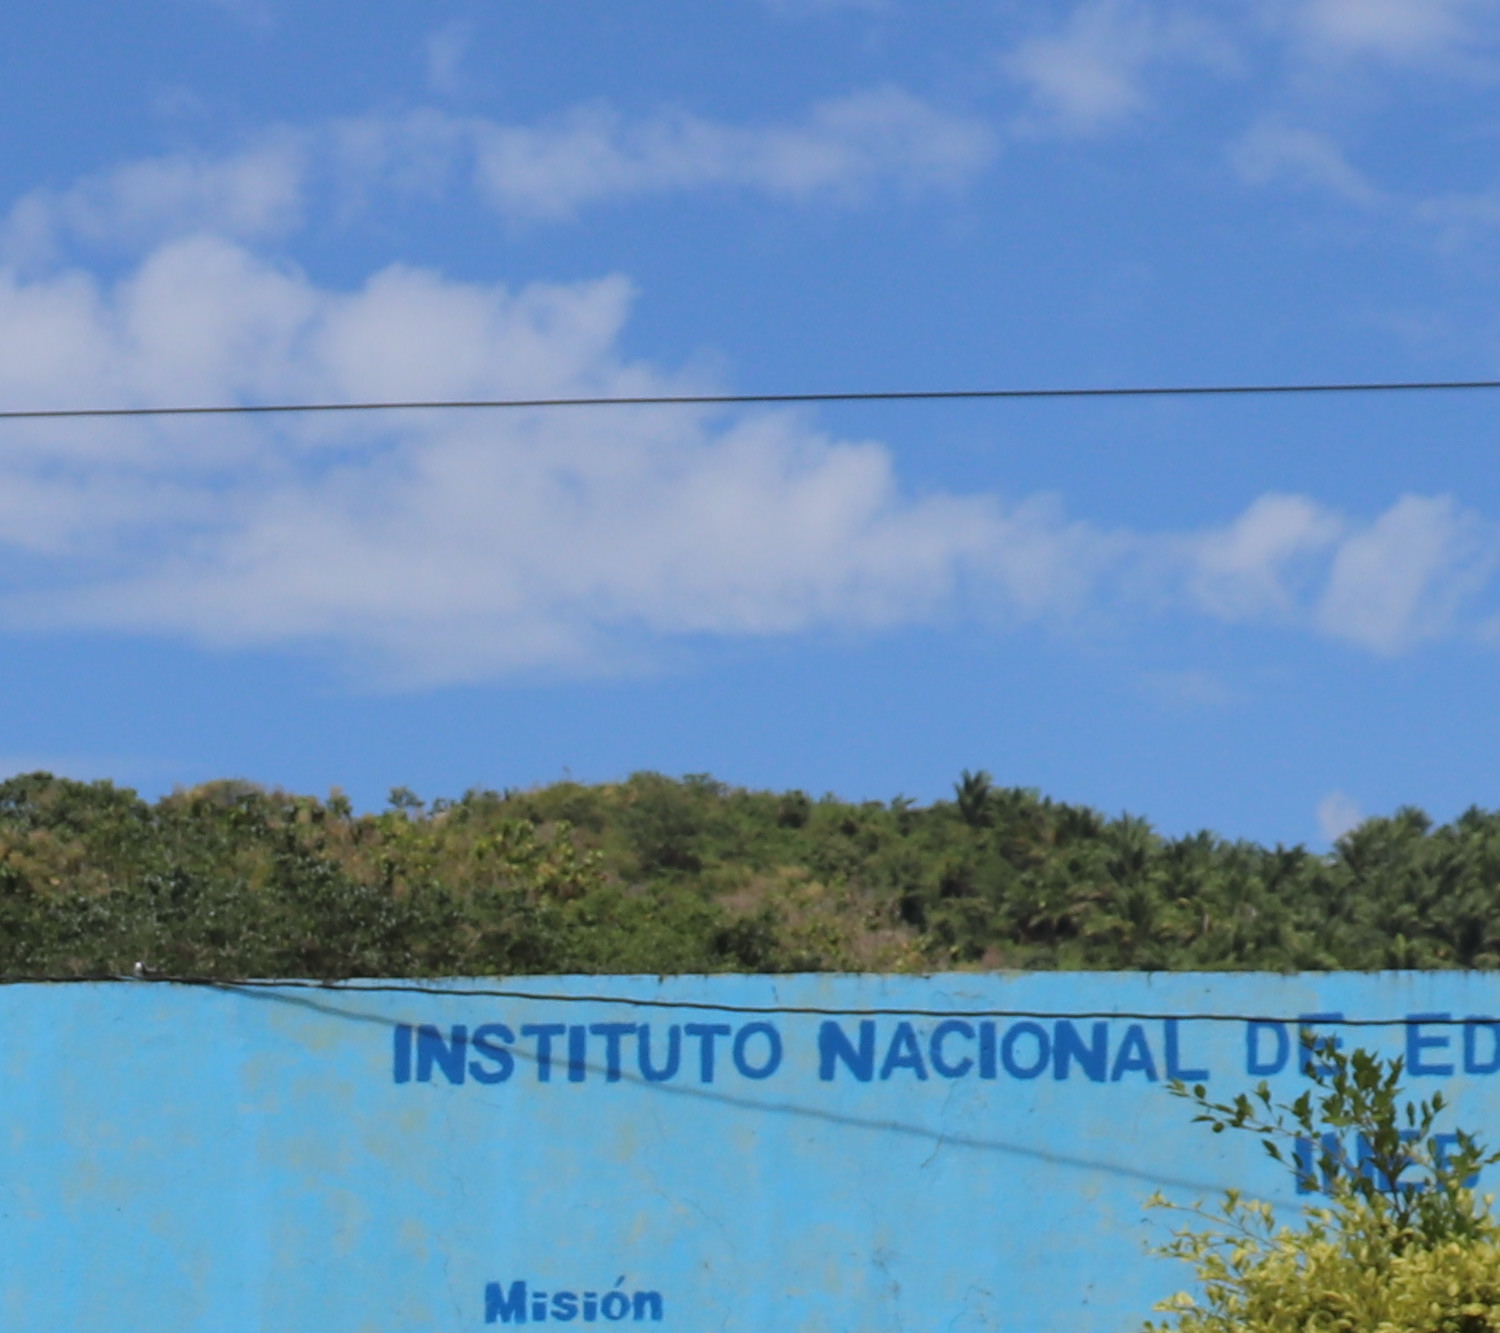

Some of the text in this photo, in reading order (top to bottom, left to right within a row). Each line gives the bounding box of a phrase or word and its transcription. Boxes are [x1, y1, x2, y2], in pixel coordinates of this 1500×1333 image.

[393, 1020, 783, 1085] INSTITUTO
[818, 1018, 1209, 1083] NACIONAL
[1246, 1012, 1344, 1076] DE
[484, 1276, 663, 1325] Misión
